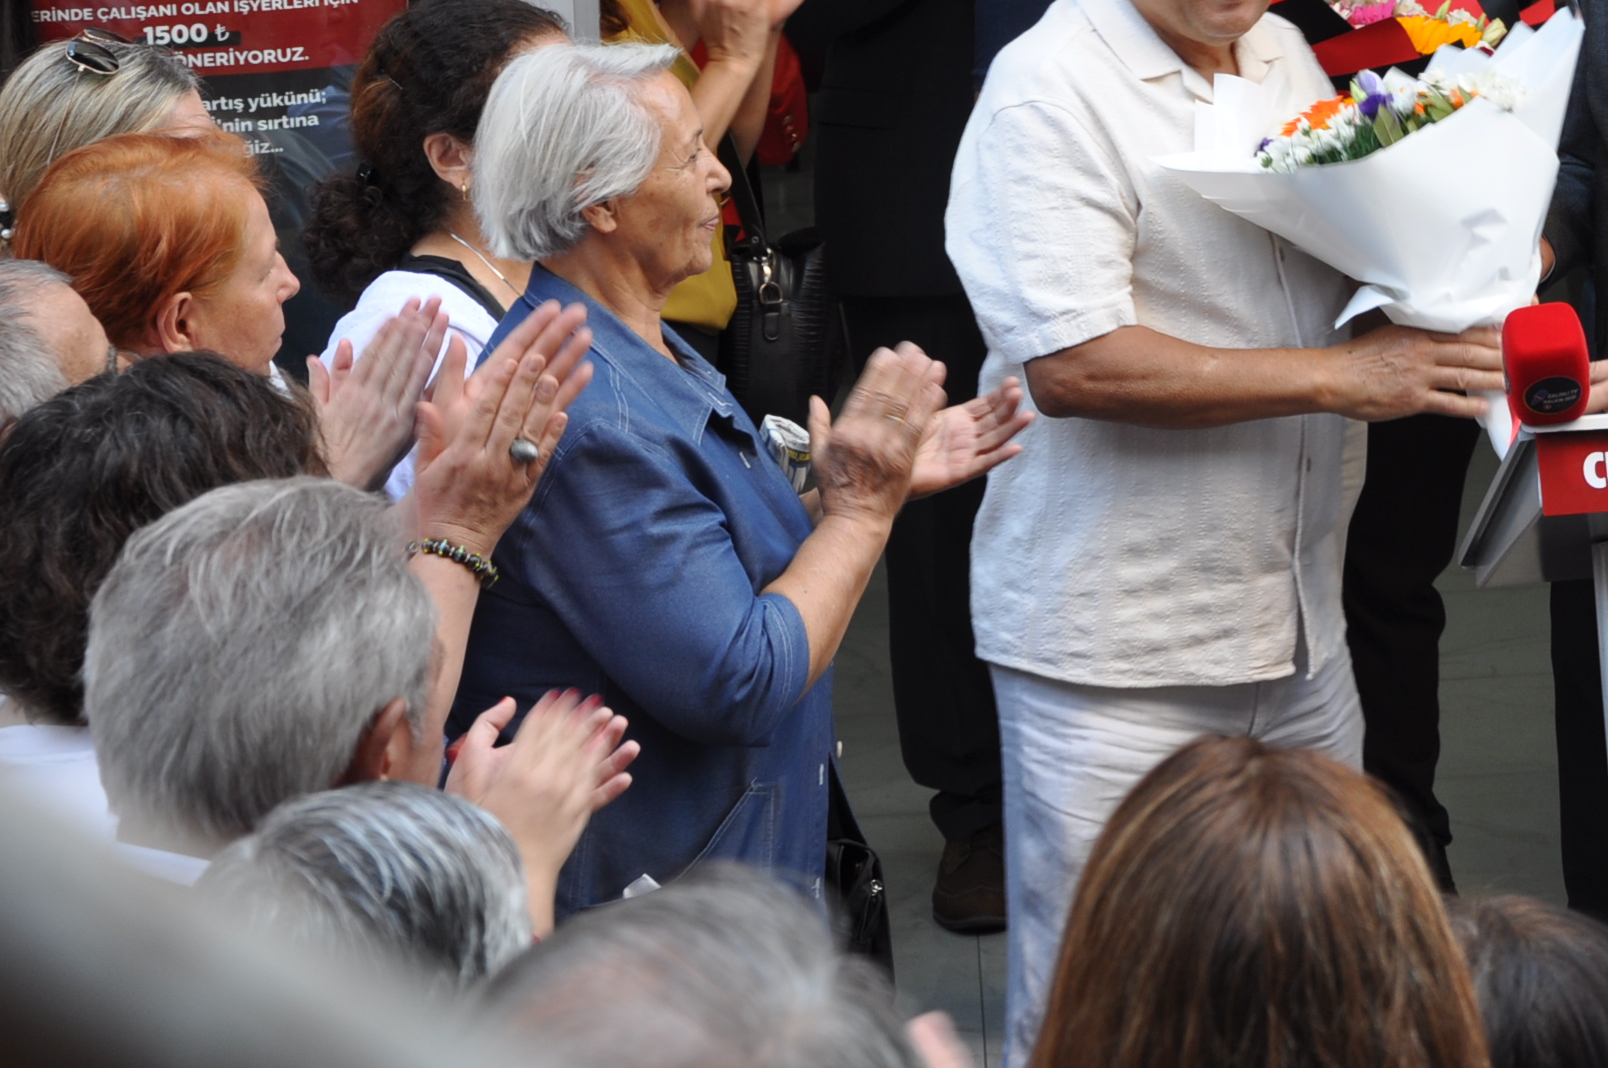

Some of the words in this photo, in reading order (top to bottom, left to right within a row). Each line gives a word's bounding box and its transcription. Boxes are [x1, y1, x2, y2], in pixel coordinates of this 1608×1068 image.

[97, 4, 177, 23] ÇALIŞANI
[181, 1, 230, 16] OLAN
[143, 23, 208, 46] 1500
[248, 90, 326, 114] yükünü;
[257, 114, 319, 131] sırtına
